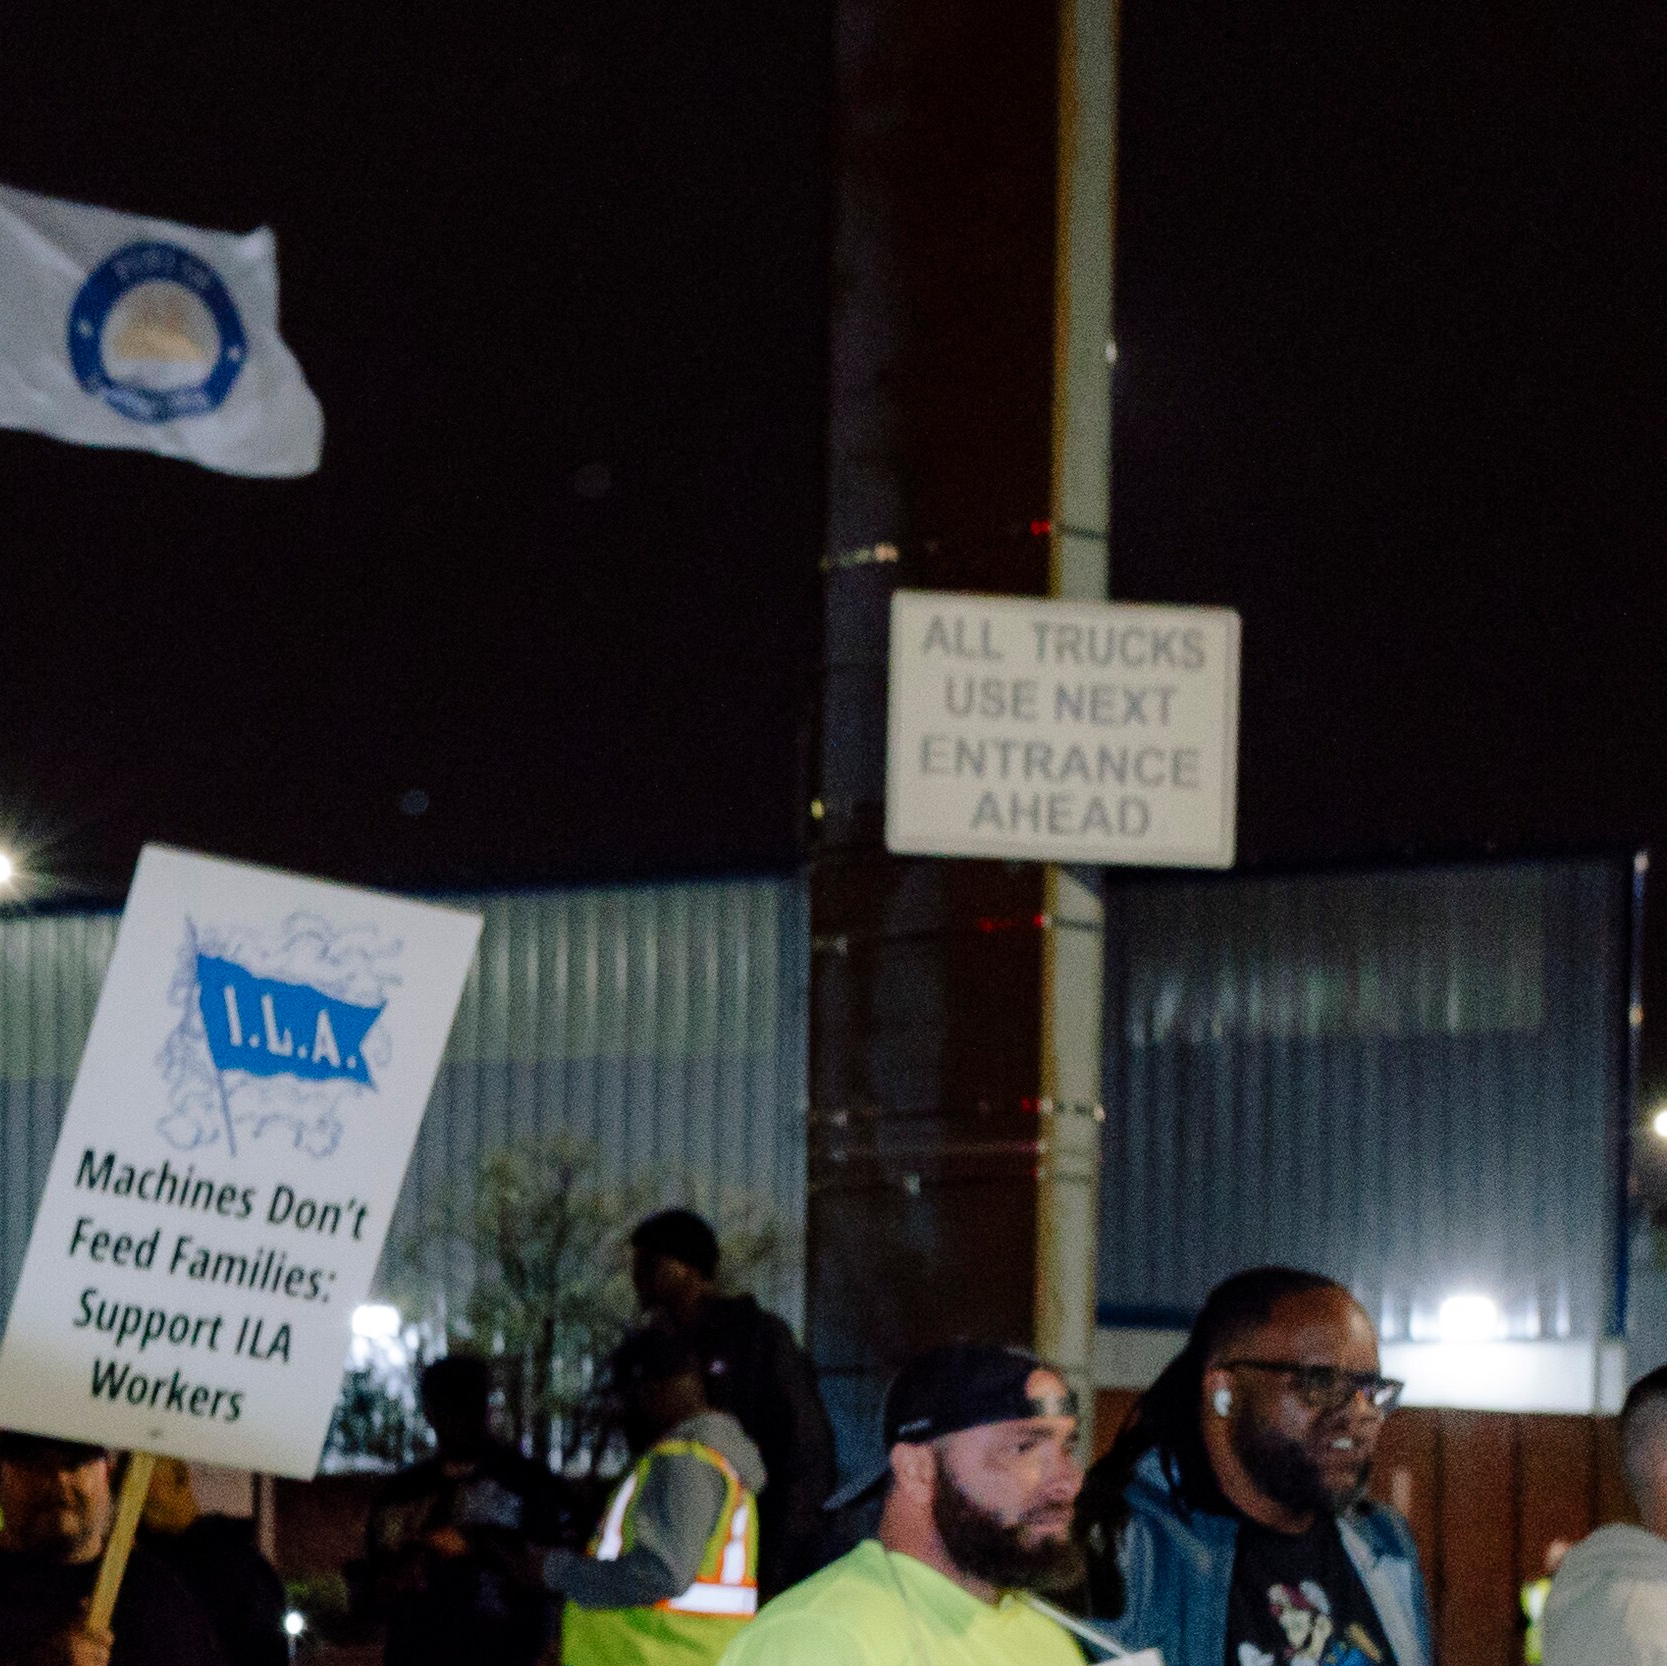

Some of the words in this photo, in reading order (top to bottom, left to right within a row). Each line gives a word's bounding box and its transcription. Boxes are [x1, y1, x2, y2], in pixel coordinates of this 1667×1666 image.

[922, 614, 1004, 662] ALL
[1033, 619, 1208, 672] TRUCKS
[943, 675, 1040, 722] USE
[1053, 681, 1177, 727] NEXT
[920, 734, 1201, 791] ENTRANCE
[969, 789, 1153, 839] AHEAD
[224, 985, 358, 1070] I.L.A.
[75, 1147, 255, 1220] Machines
[266, 1184, 369, 1243] Don't
[68, 1217, 162, 1270] Feed
[170, 1235, 338, 1305] Families:
[73, 1288, 220, 1354] Support
[234, 1317, 293, 1366] ILA
[89, 1358, 245, 1426] Workers
